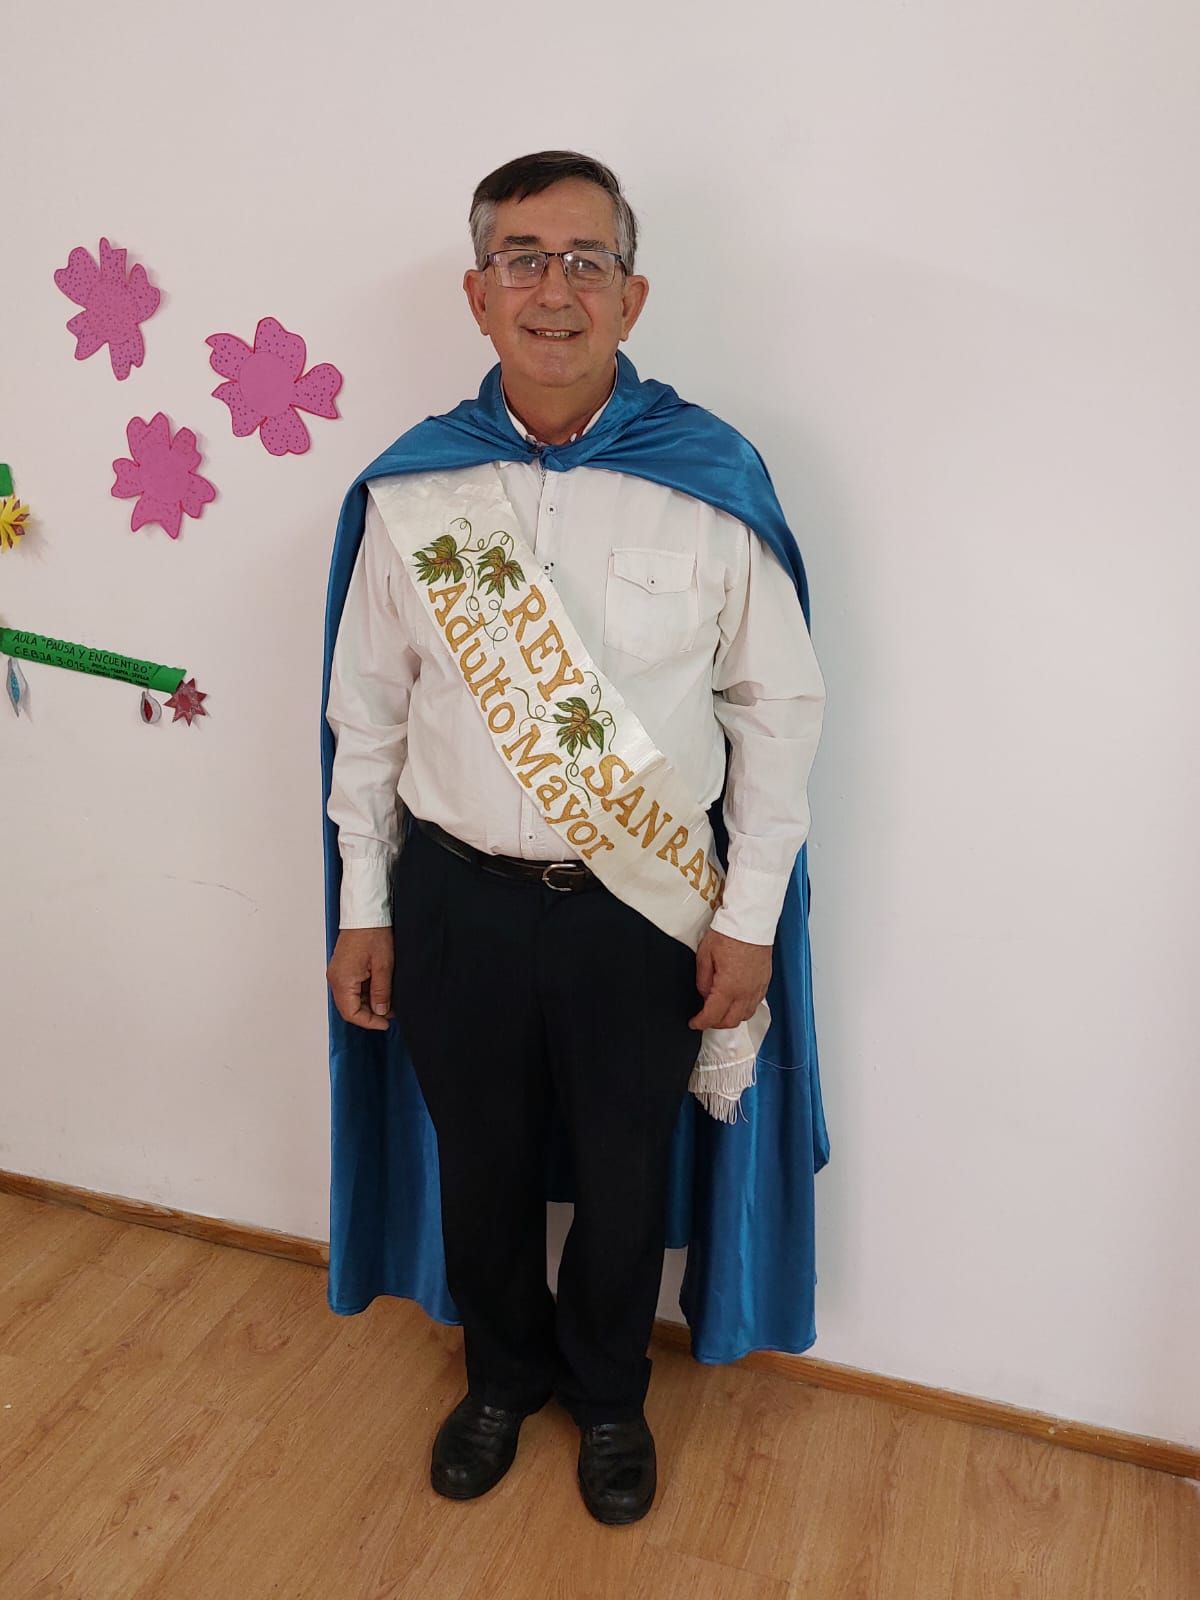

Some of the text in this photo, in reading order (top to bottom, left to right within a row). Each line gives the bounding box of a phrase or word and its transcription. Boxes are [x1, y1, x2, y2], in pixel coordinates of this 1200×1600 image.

[12, 632, 38, 646] AULA
[78, 649, 86, 659] Y
[428, 582, 615, 860] Adulto Mayor
[503, 585, 584, 702] REY
[581, 755, 673, 848] SAN
